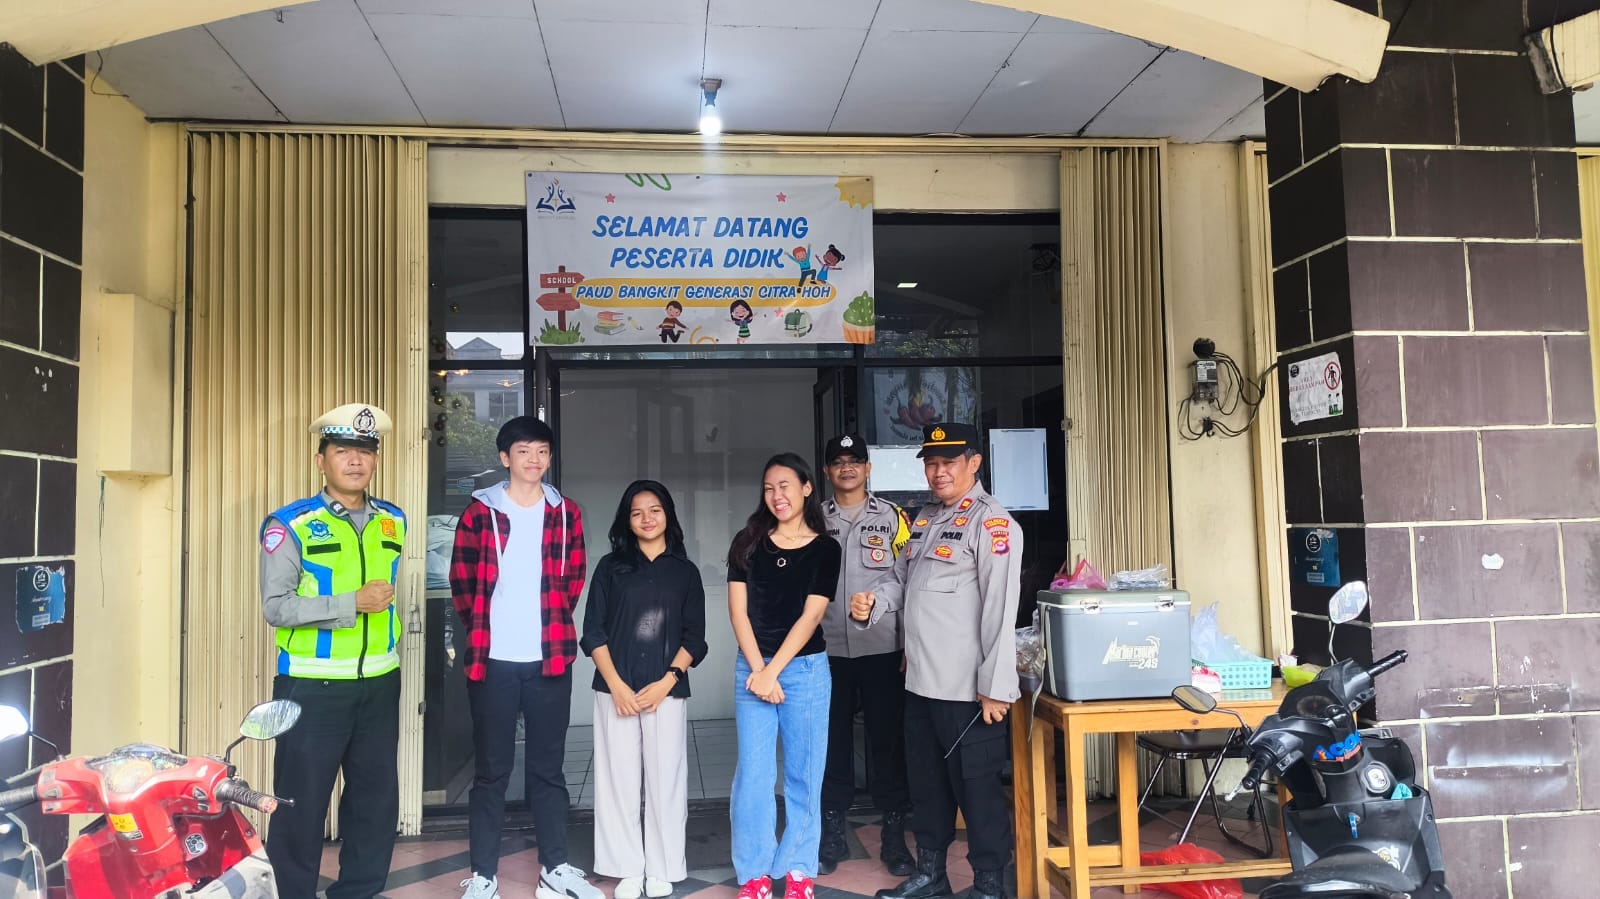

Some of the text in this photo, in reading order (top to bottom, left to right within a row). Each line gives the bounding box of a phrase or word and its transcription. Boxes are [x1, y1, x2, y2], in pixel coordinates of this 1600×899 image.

[592, 215, 809, 239] SELAMAT DATANG
[610, 247, 785, 269] PESERTA DIDIK
[546, 276, 577, 284] SCHOOL
[576, 286, 831, 299] PAUD BANGKIT GENERASI CITRA HOH
[860, 525, 889, 534] POLRI
[940, 531, 963, 541] POLRI
